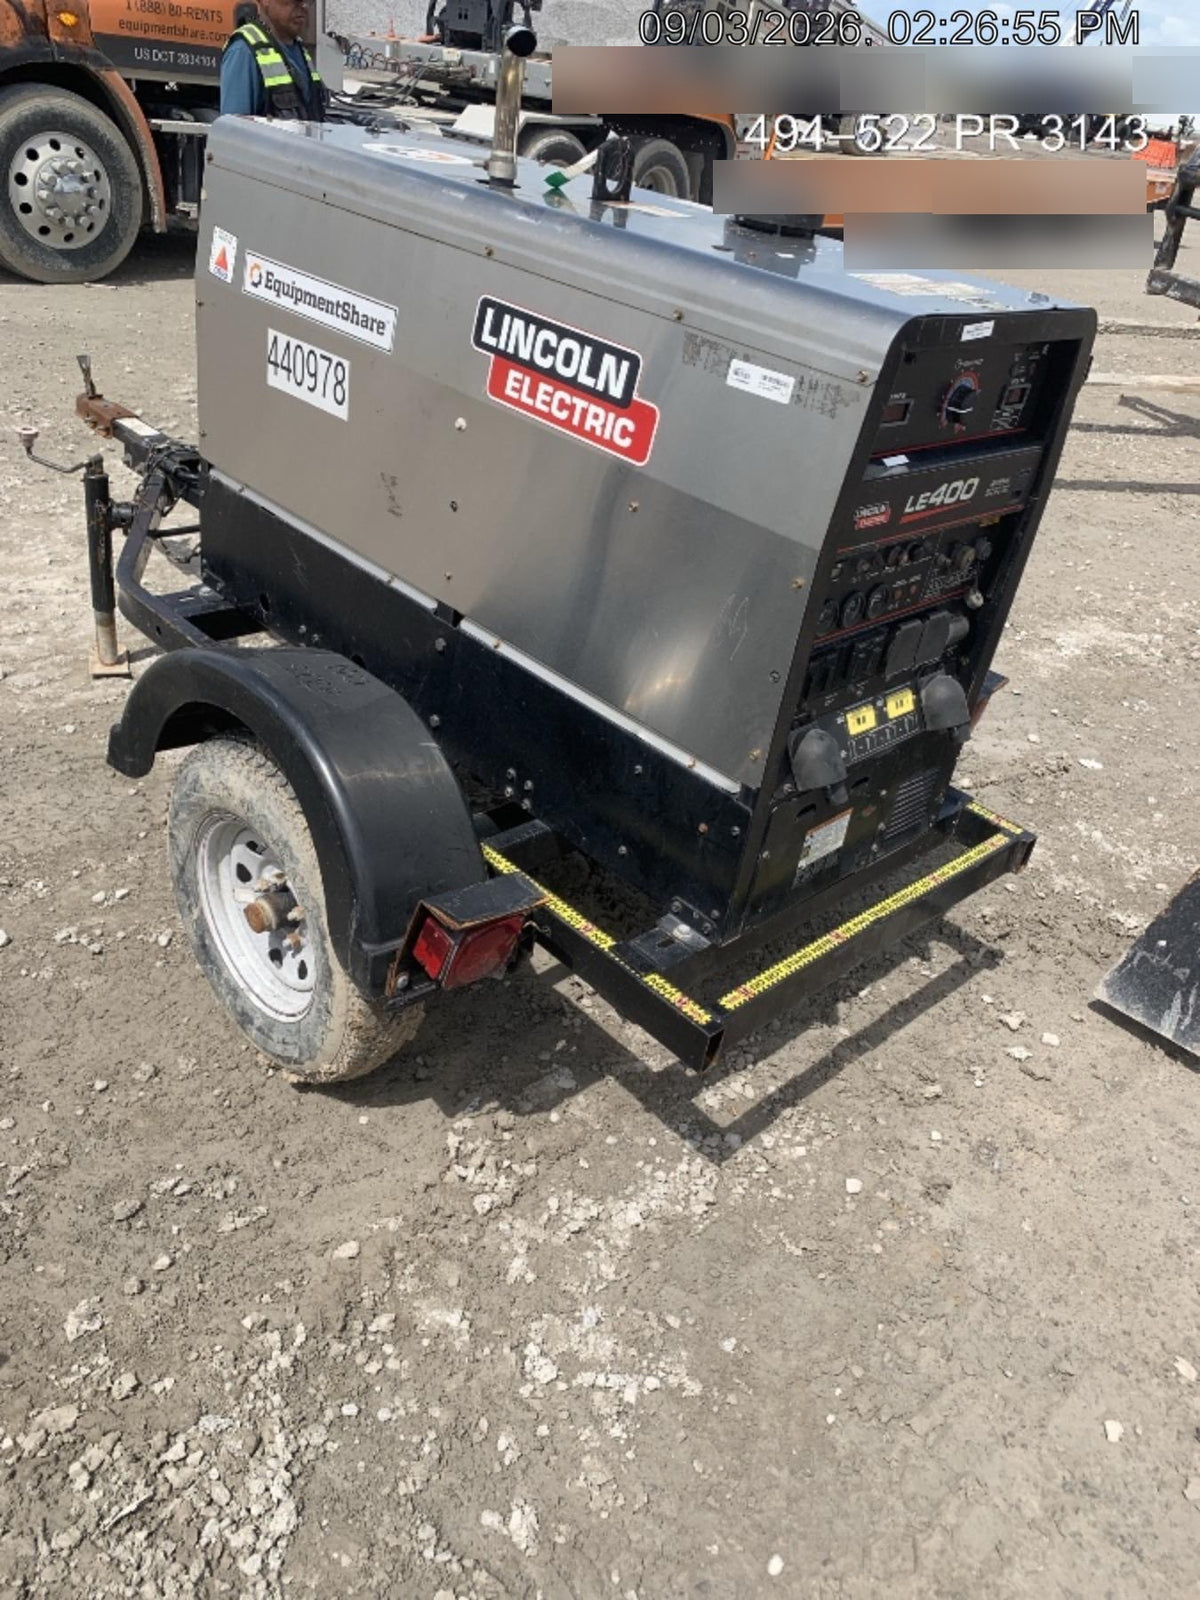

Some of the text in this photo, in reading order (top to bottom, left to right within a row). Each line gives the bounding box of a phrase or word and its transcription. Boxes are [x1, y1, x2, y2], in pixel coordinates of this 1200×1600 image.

[169, 4, 223, 23] 80-RENTS
[134, 47, 150, 60] US
[264, 271, 386, 336] EquipmentShare
[267, 335, 346, 406] 440978
[481, 306, 630, 399] LINCOLN
[504, 368, 635, 448] ELECTRIC
[904, 477, 980, 513] LE400
